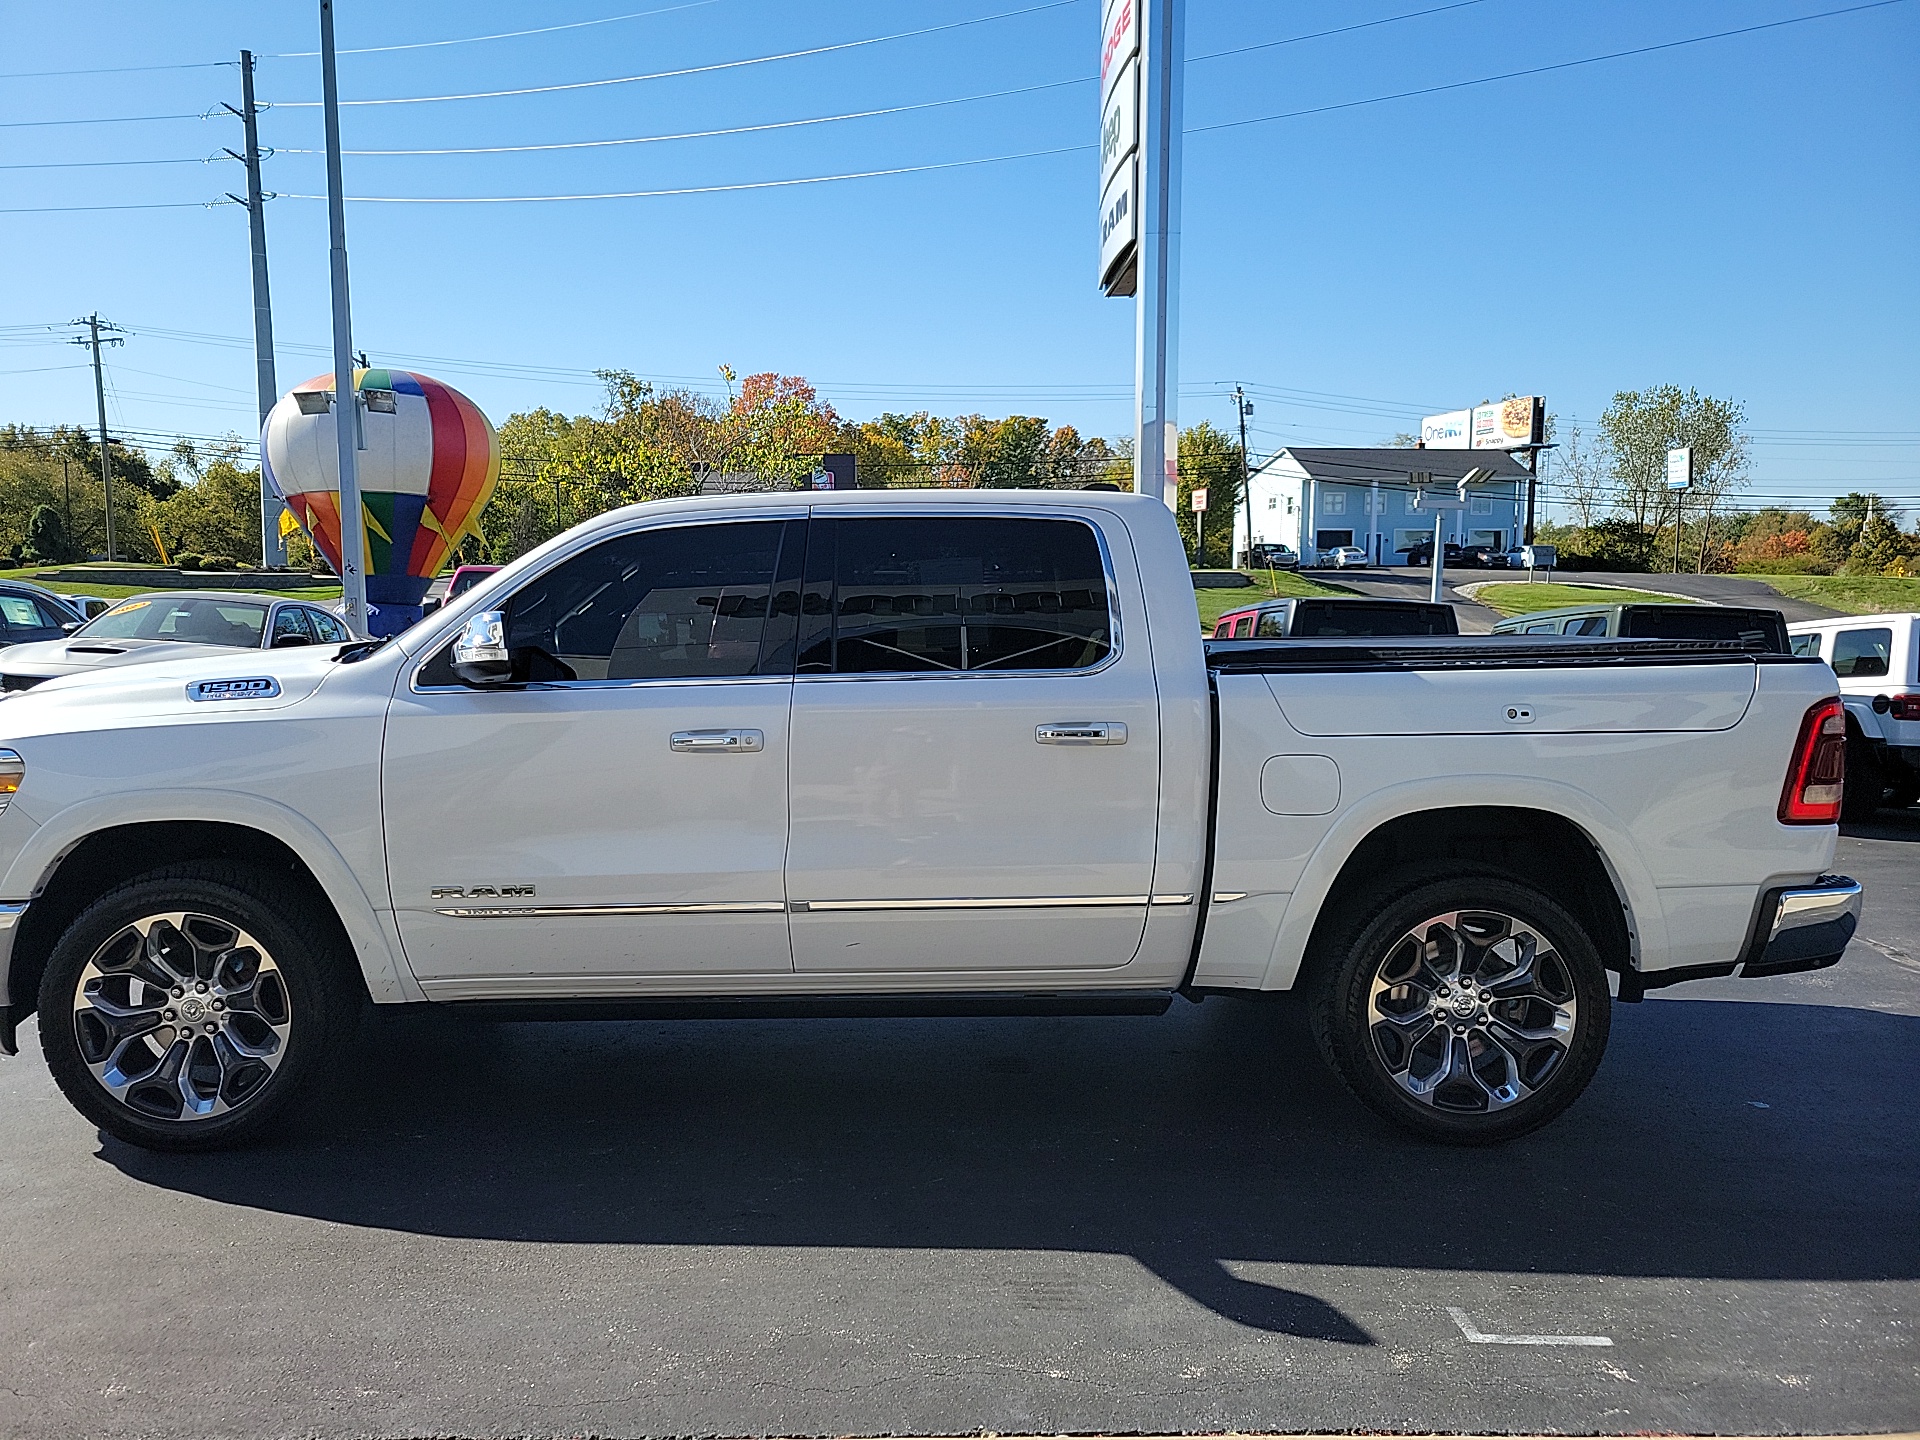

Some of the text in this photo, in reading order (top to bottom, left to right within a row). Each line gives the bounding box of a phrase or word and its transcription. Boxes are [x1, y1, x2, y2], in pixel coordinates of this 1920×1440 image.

[1101, 0, 1131, 97] ODGE
[202, 681, 267, 693] 1500
[430, 884, 536, 899] RAM
